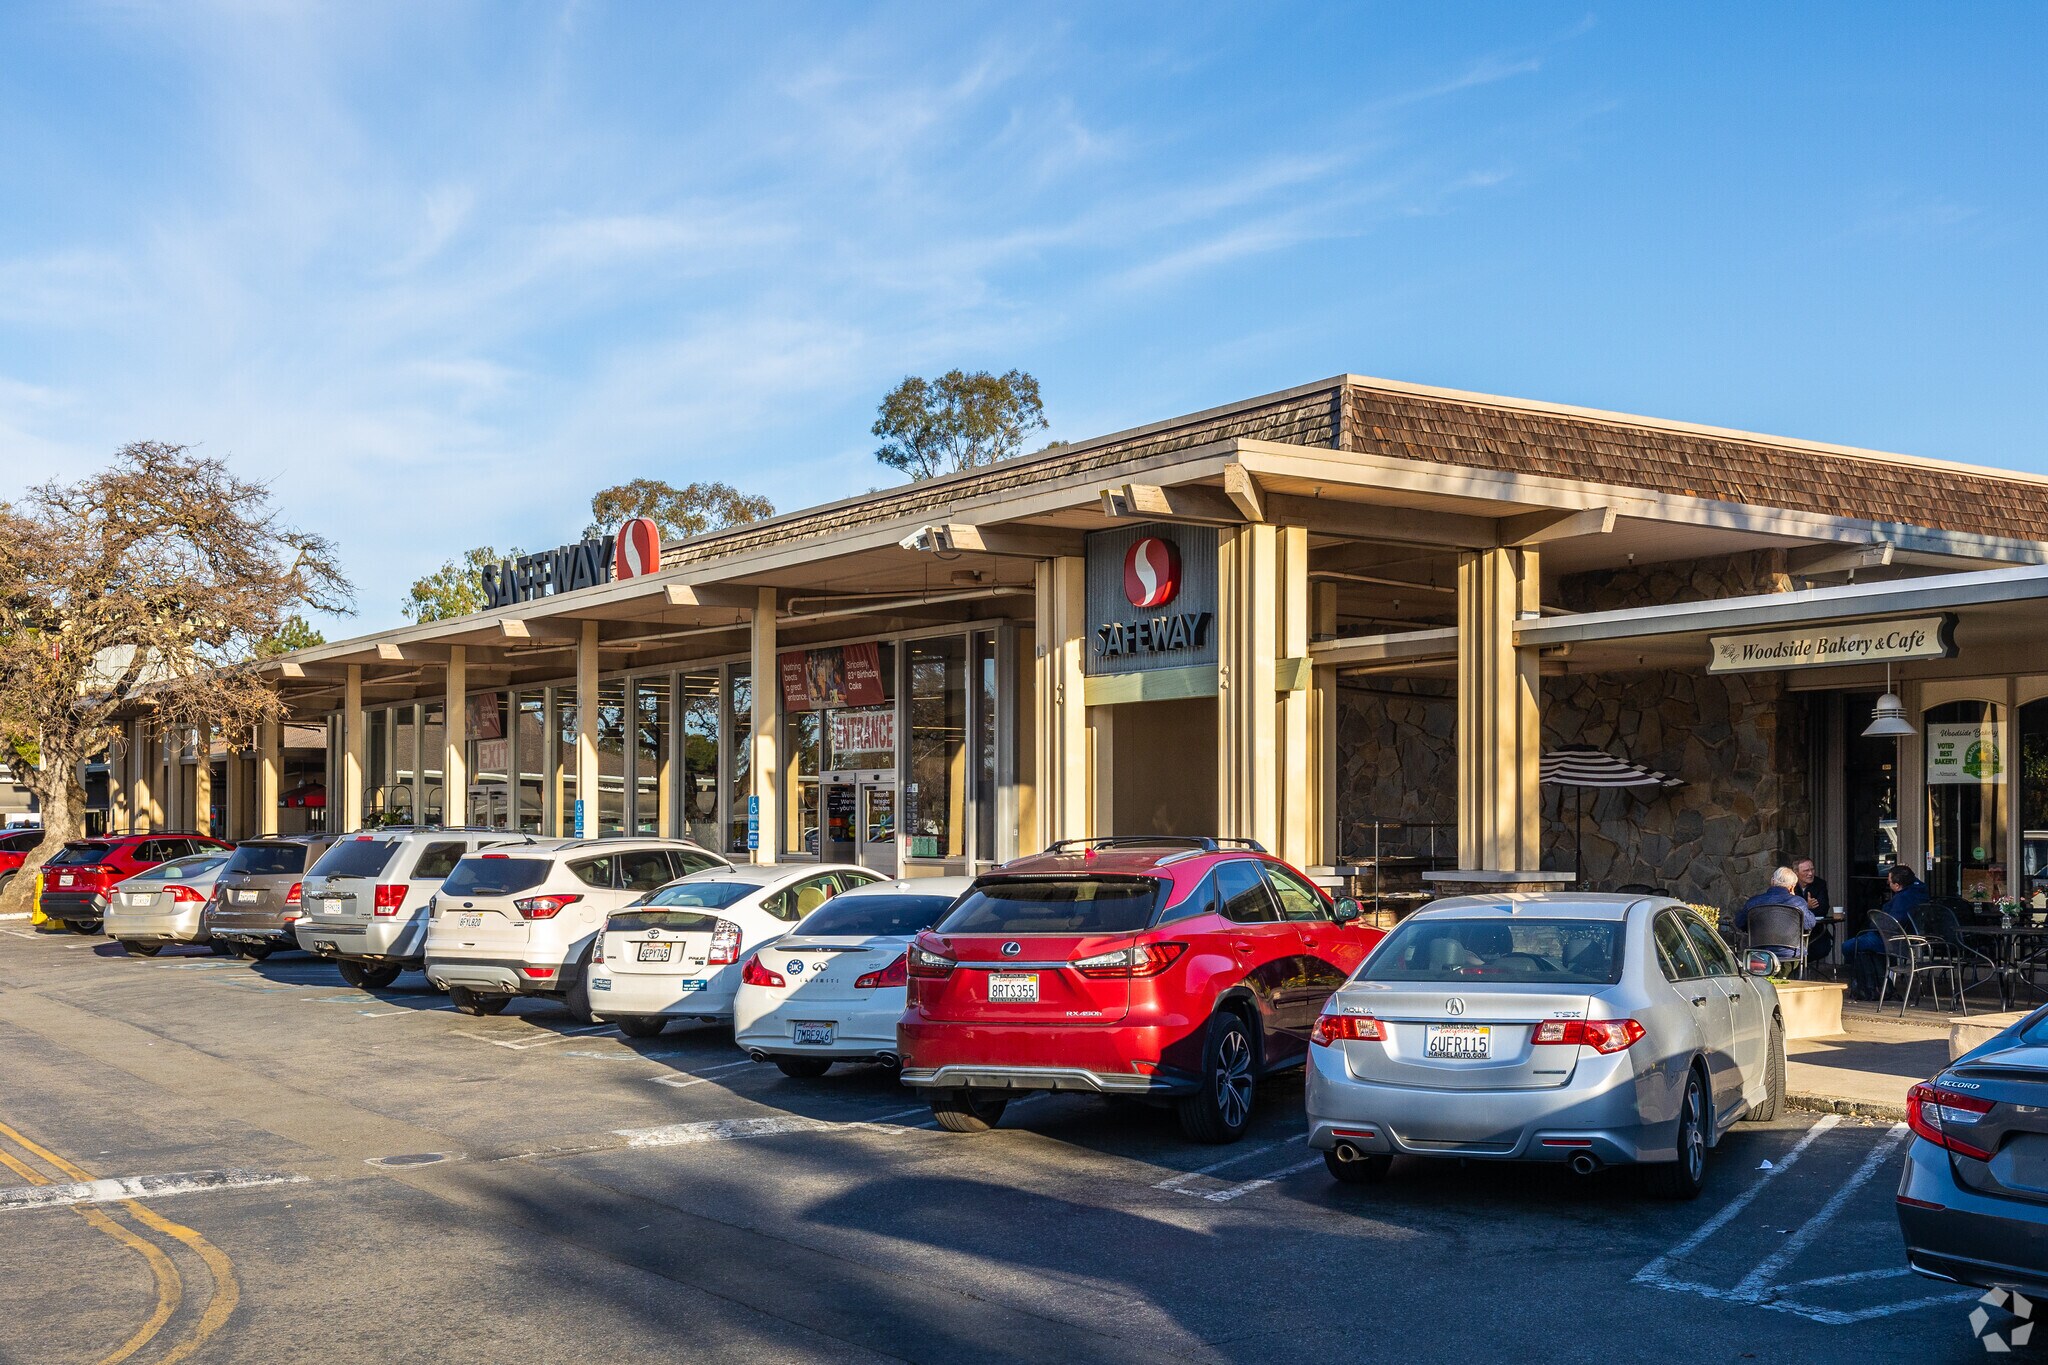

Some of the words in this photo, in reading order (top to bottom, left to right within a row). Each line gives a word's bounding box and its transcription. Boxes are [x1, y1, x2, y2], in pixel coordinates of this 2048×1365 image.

[482, 535, 616, 610] SAFEWAY
[1094, 612, 1211, 656] SAFEWAY
[1743, 640, 1811, 661] Woodside
[1816, 636, 1873, 656] Bakery
[1886, 630, 1925, 653] Café
[783, 662, 802, 673] Nothing
[846, 660, 870, 670] Sincerely,
[784, 674, 798, 682] beats
[857, 670, 879, 680] Birthday
[790, 683, 802, 694] great
[848, 682, 862, 690] Cake
[788, 693, 808, 702] entrance.
[836, 714, 894, 750] ENTRANCE
[1940, 728, 1972, 737] Woodside
[1973, 728, 1998, 738] Bakery
[480, 742, 507, 769] EXIT
[641, 948, 669, 959] 6EPY745
[992, 984, 1035, 998] 8RTS355
[797, 1029, 830, 1041] 7MBF946
[1440, 1027, 1476, 1036] California
[1430, 1036, 1487, 1053] 6UFR115
[1428, 1051, 1487, 1059] HANSELAUTO.COM
[1940, 1080, 1980, 1090] ACCORD
